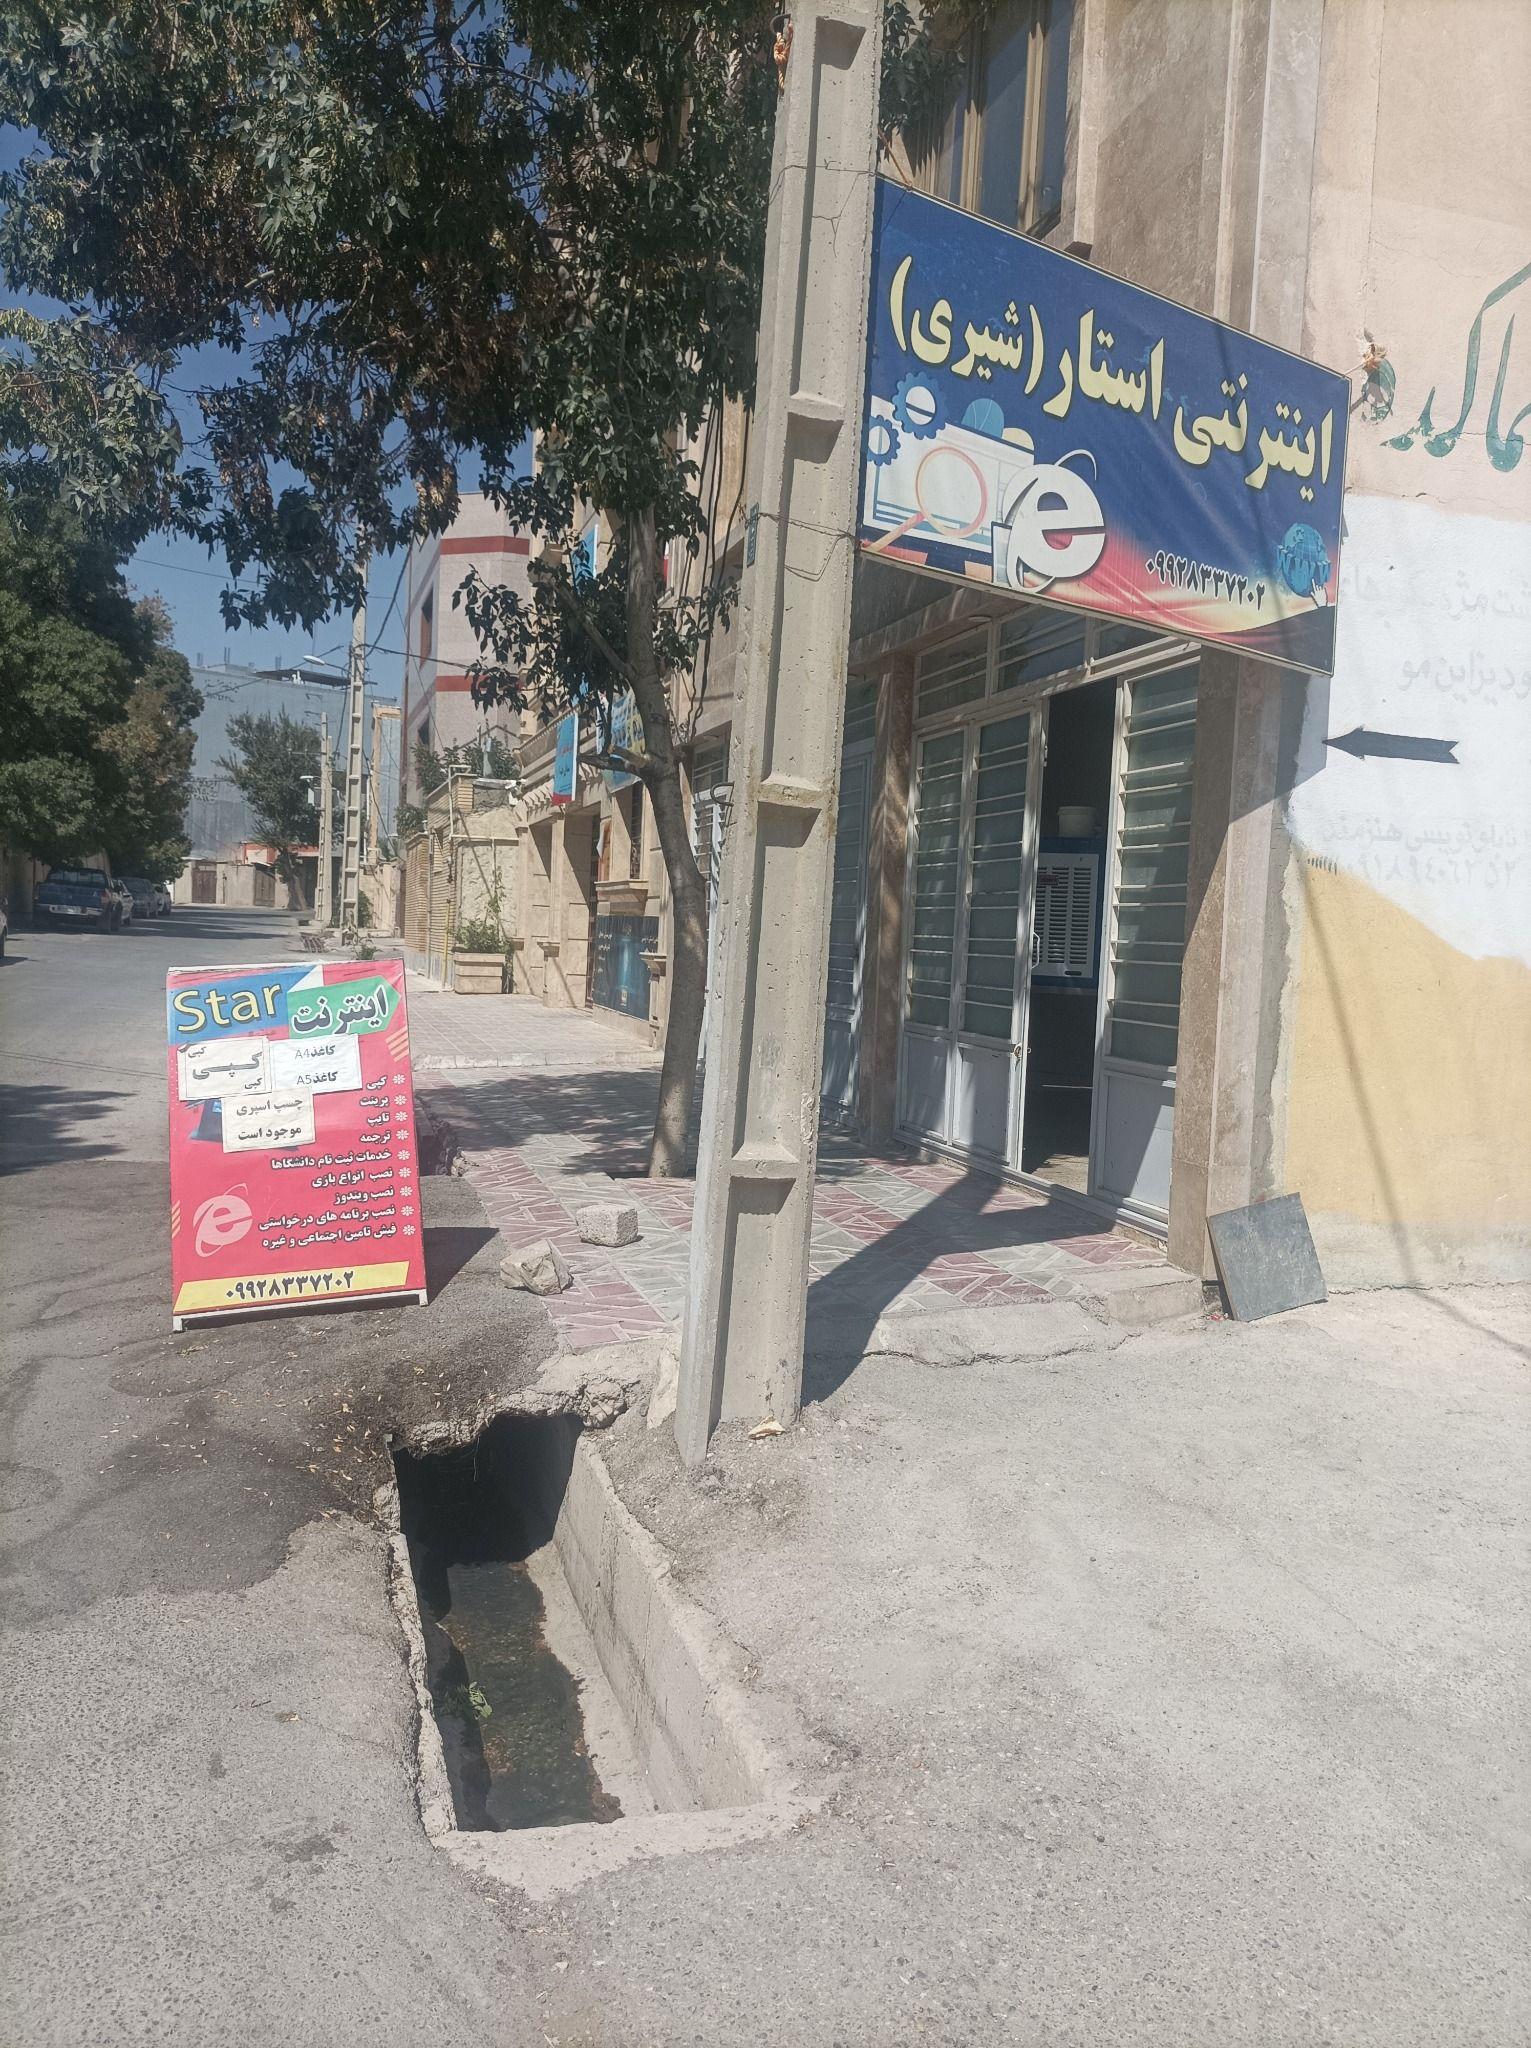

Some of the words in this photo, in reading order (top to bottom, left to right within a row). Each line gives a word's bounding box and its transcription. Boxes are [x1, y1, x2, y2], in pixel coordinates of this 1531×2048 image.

[889, 256, 1044, 395] (شیری)
[1043, 309, 1164, 420] استار
[1173, 373, 1333, 502] اینترنتی
[1145, 549, 1266, 611] ۰۹۹۲۸۳۳۷۲۰۲
[173, 984, 282, 1034] Star
[293, 985, 388, 1035] اینترنت
[193, 1051, 264, 1081] کپی
[366, 1075, 388, 1090] کپی
[236, 1099, 271, 1117] اسپری
[367, 1112, 390, 1127] تایپ
[238, 1127, 263, 1141] است
[265, 1127, 302, 1141] موجود
[360, 1130, 391, 1144] ترجمه
[317, 1155, 333, 1168] نام
[334, 1152, 354, 1165] ثبت
[356, 1149, 392, 1163] خدمات
[312, 1173, 336, 1188] بازی
[338, 1170, 365, 1185] انواع
[369, 1167, 393, 1181] نصب
[334, 1191, 369, 1205] ویندوز
[370, 1186, 394, 1199] نصب
[316, 1211, 337, 1225] های
[340, 1208, 369, 1221] برنامه
[371, 1205, 396, 1219] نصب
[298, 1229, 342, 1246] اجتماعی
[373, 1223, 397, 1239] فیش
[262, 1234, 286, 1249] غیره
[226, 1270, 354, 1300] ۰۹۹۲۸۳۳۷۲۰۲
